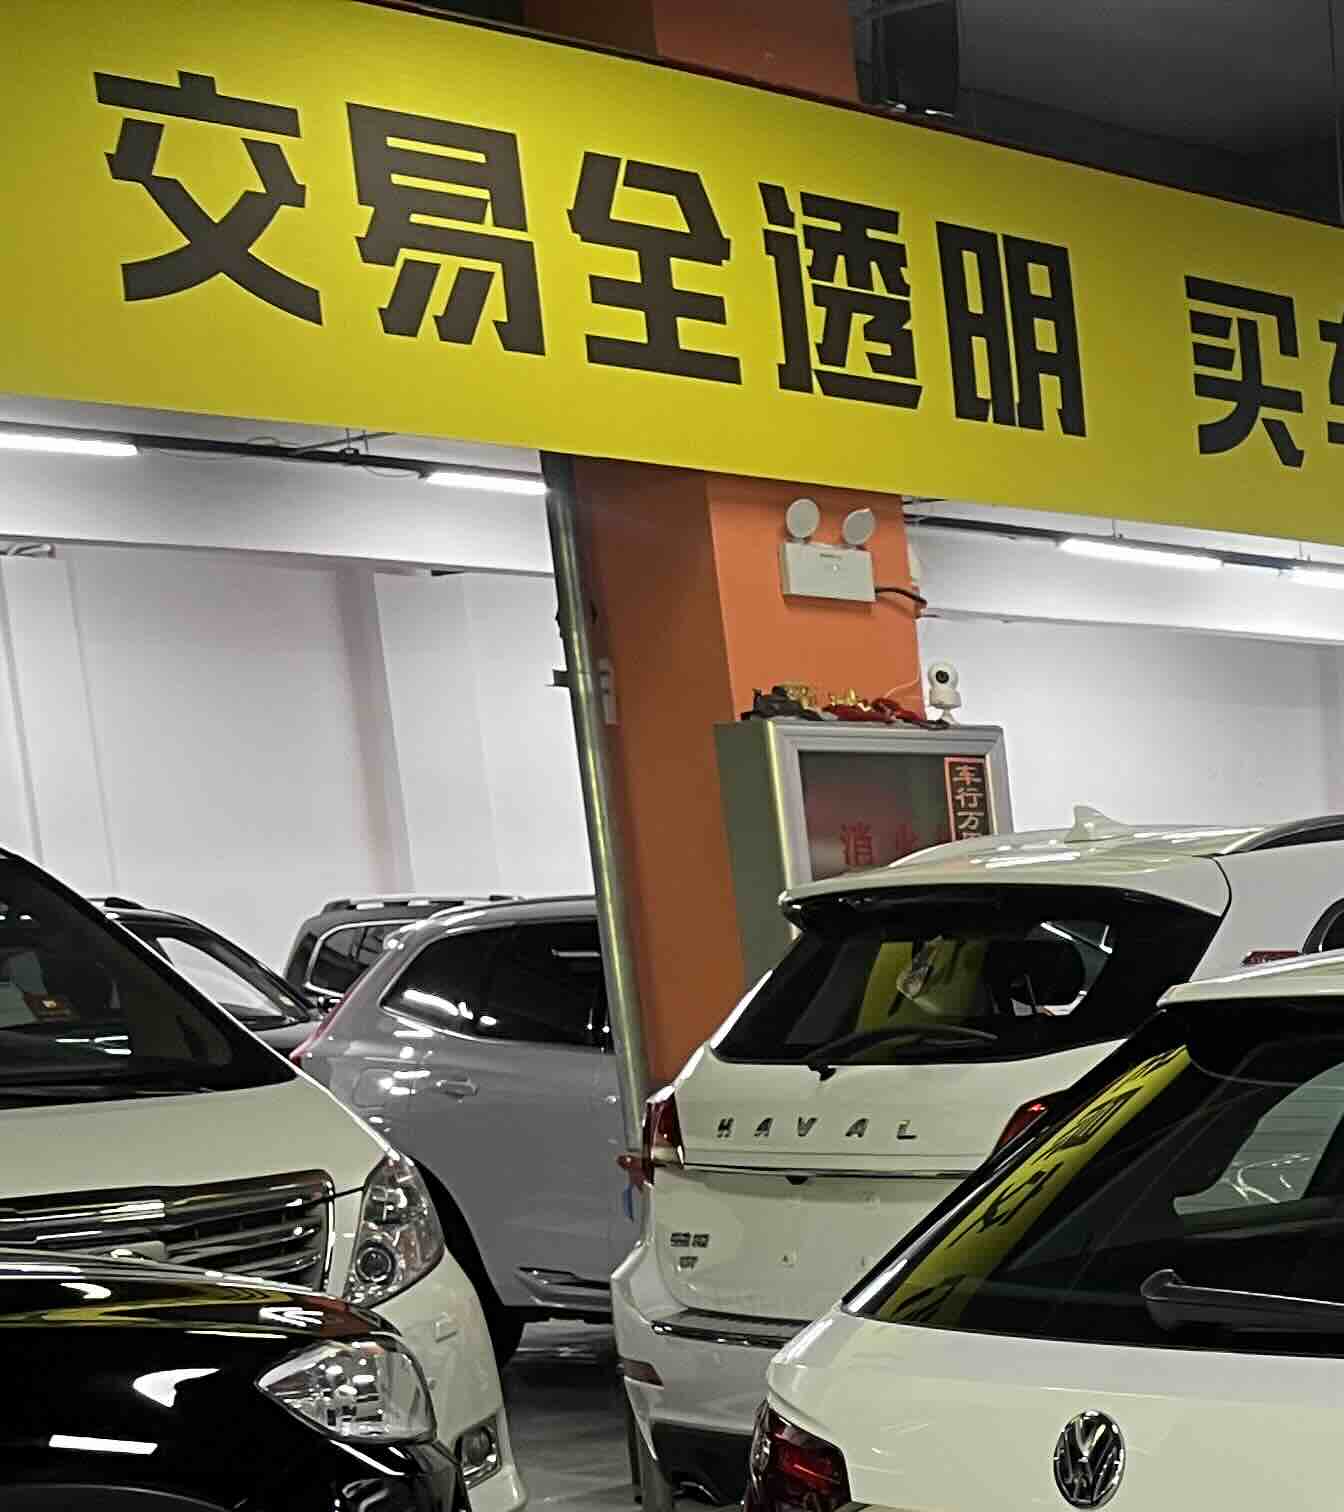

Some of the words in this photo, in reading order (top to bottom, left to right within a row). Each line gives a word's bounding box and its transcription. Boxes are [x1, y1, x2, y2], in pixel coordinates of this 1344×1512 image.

[93, 70, 1087, 437] 交易全透明
[717, 1117, 918, 1141] HAVAL
